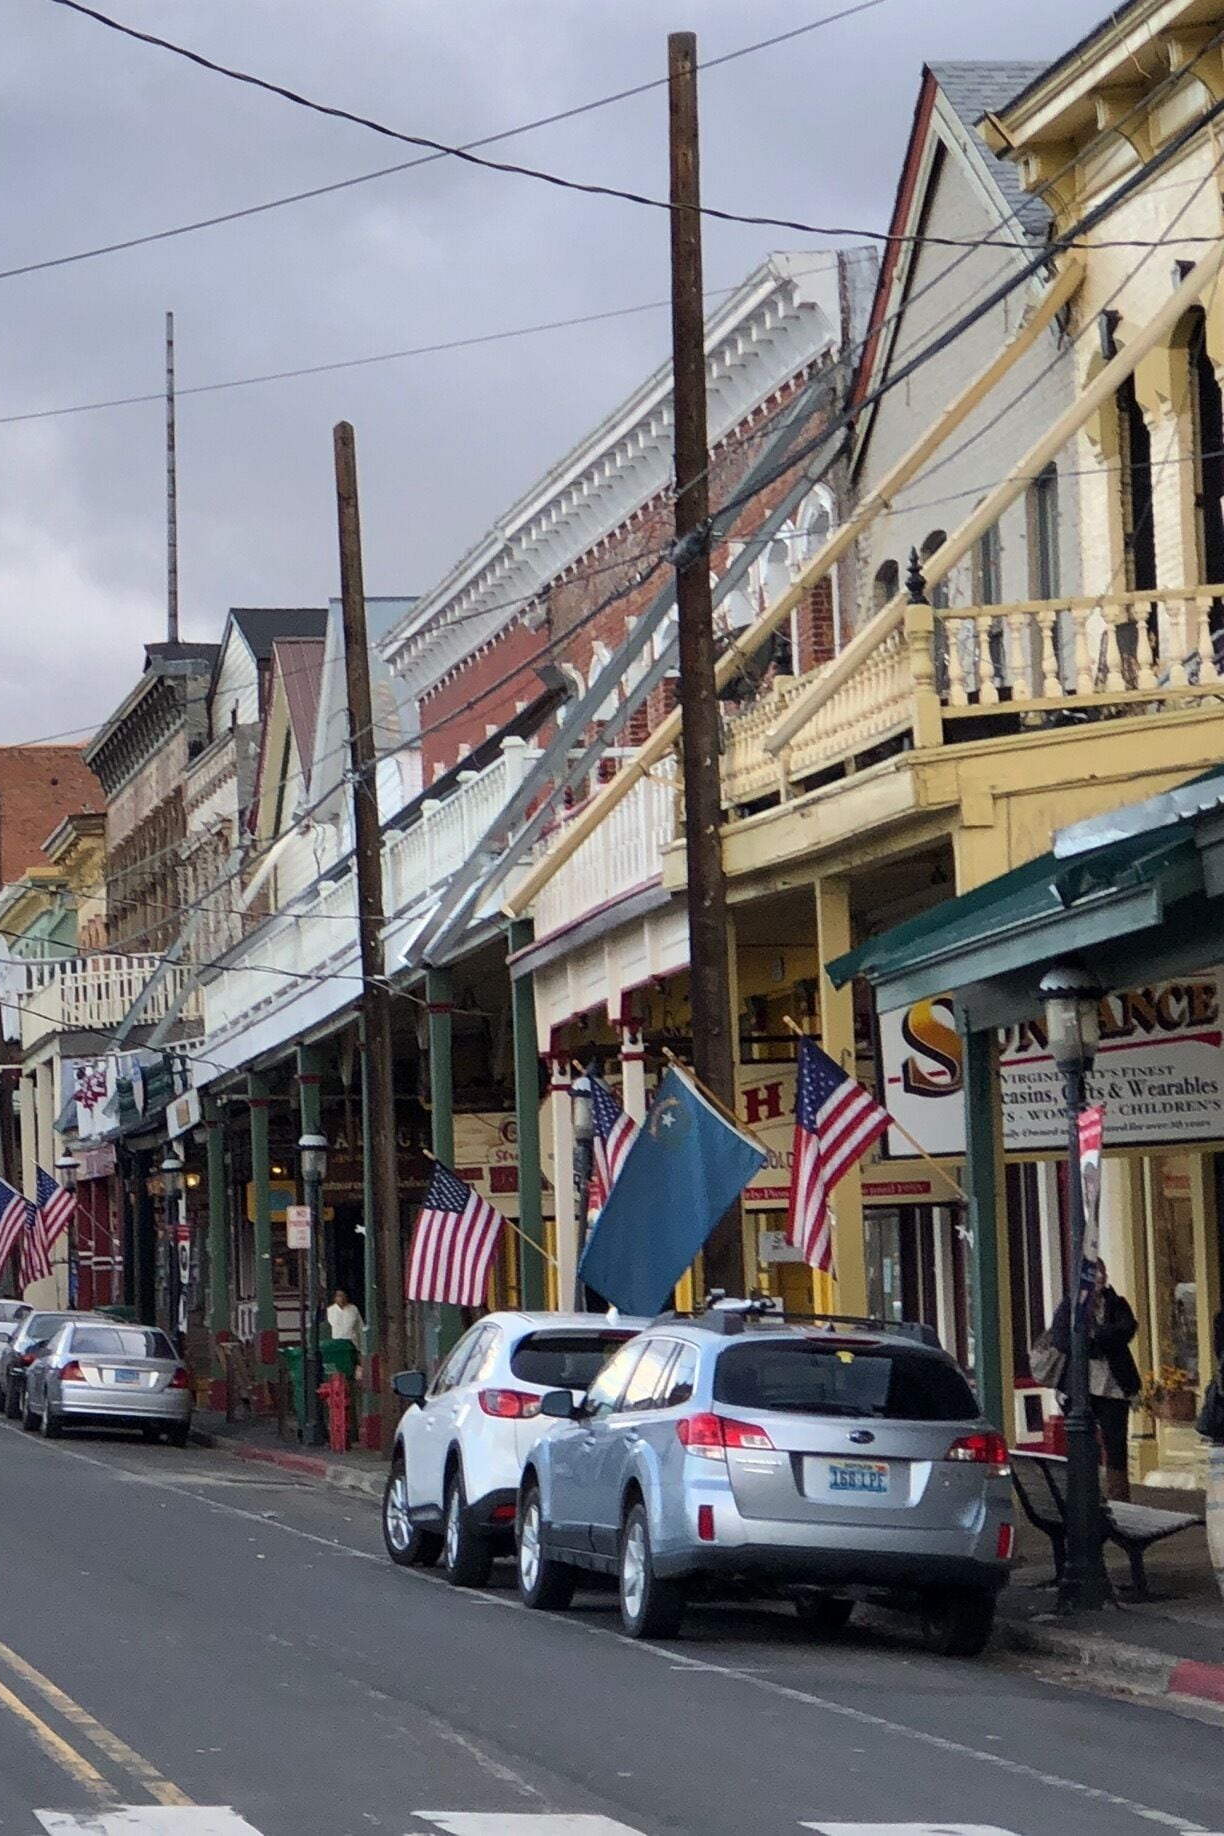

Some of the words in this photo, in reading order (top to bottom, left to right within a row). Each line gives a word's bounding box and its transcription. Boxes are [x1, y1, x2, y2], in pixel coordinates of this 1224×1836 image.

[1121, 1065, 1176, 1078] FINEST
[1001, 1085, 1058, 1105] casins,
[1108, 1082, 1122, 1099] &
[1126, 1076, 1219, 1098] Wearables
[1119, 1098, 1222, 1116] CHILDREN'S
